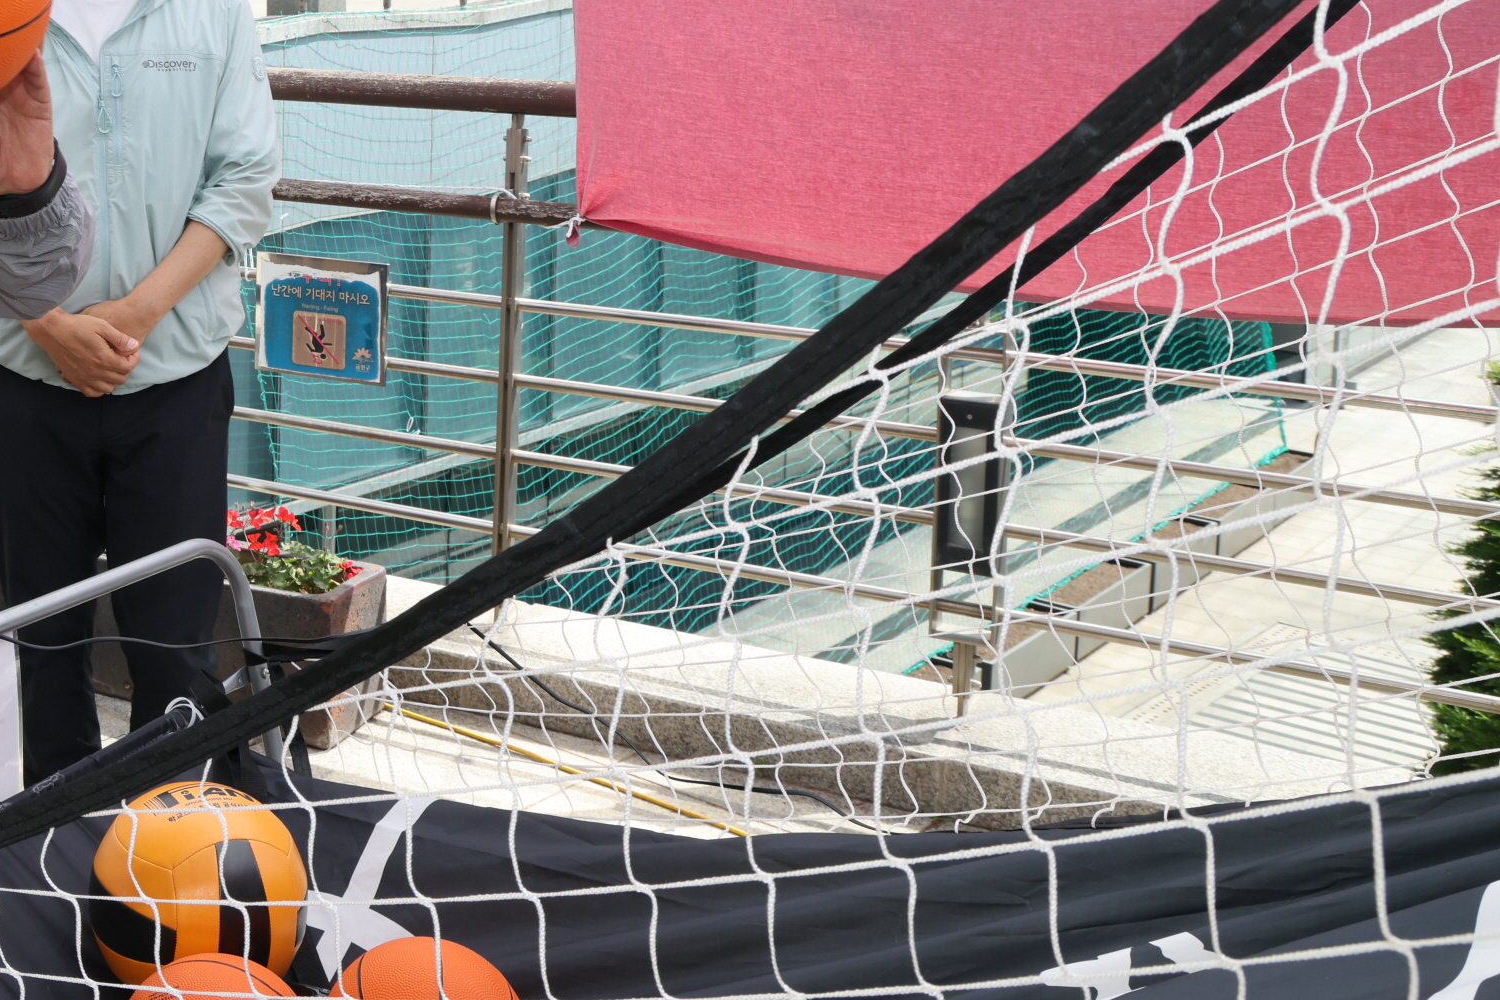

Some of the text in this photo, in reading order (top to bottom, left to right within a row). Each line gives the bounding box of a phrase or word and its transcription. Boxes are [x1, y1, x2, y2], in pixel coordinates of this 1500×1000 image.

[271, 284, 370, 305] 난간에 기대지 마시오
